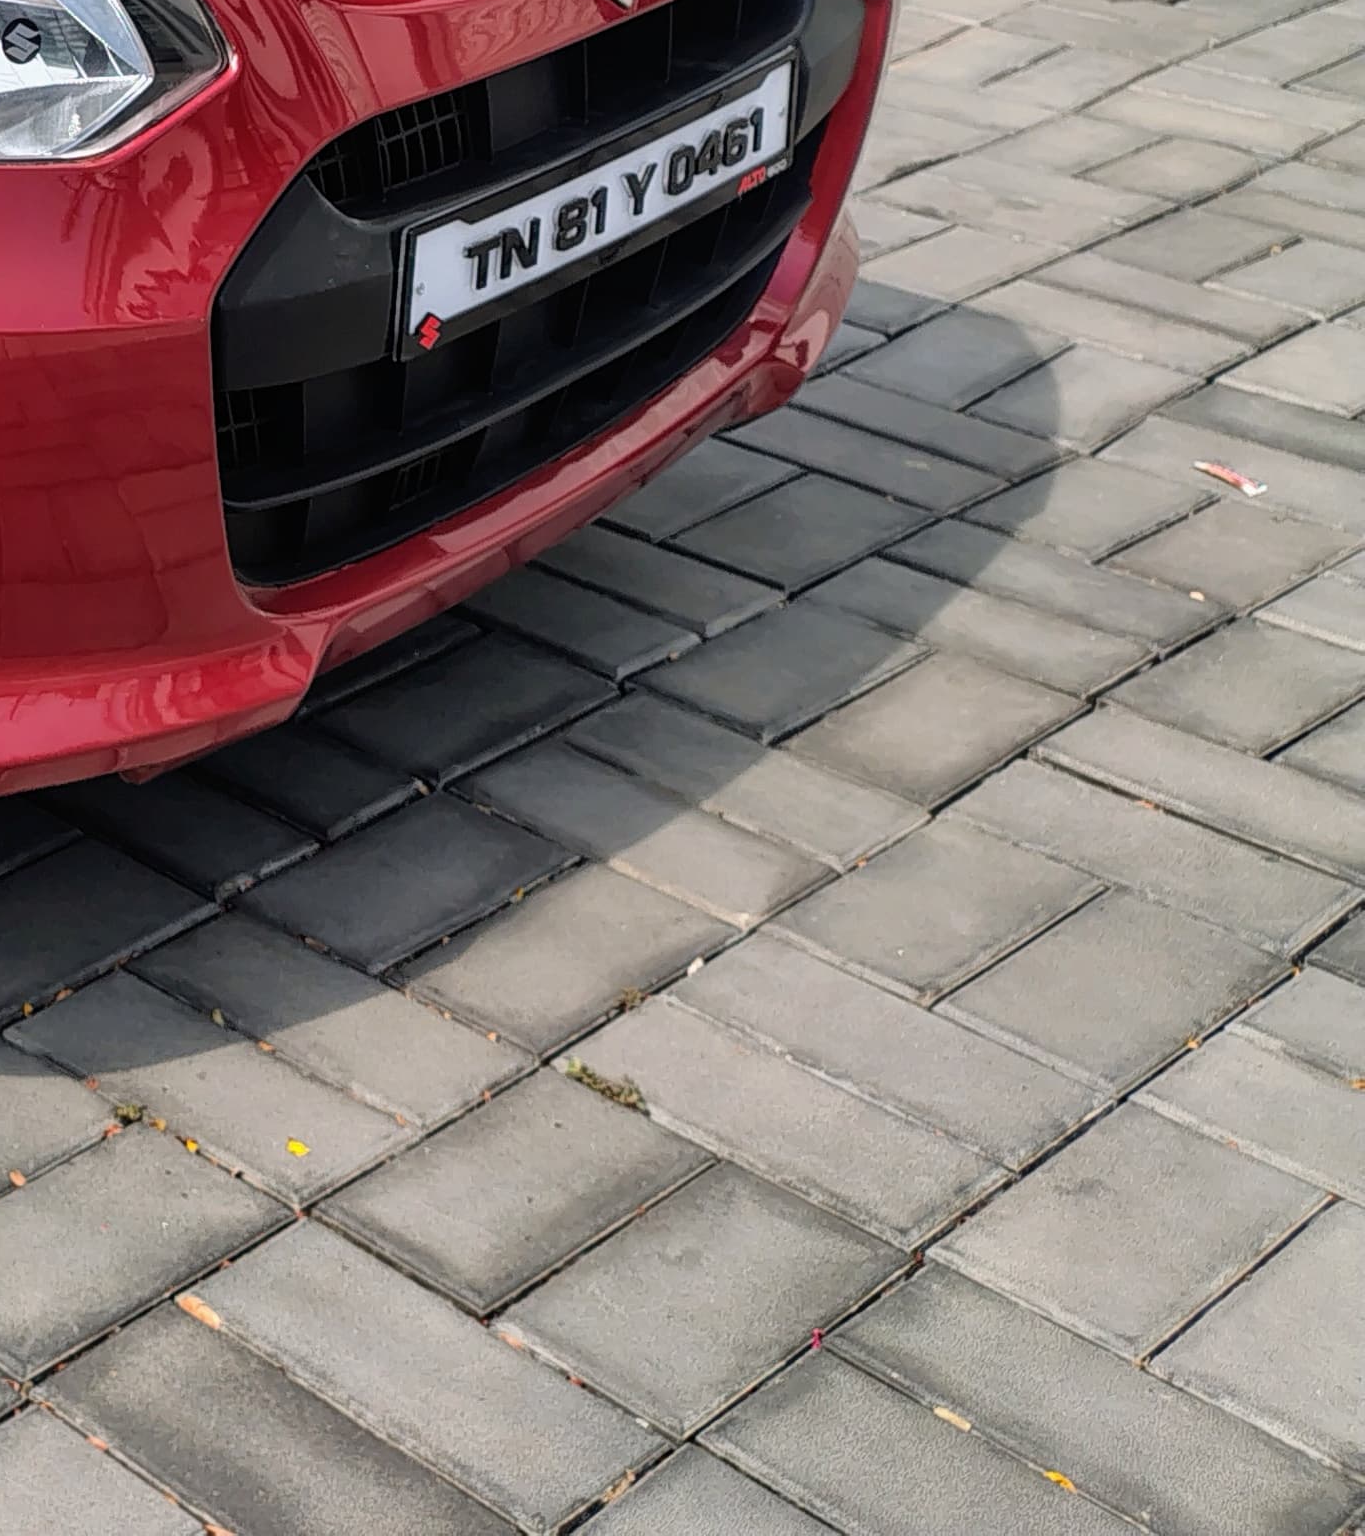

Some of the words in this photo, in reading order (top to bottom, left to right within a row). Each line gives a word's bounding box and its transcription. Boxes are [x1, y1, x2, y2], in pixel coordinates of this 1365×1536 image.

[465, 216, 541, 290] TN
[553, 186, 609, 252] 81
[622, 162, 658, 216] Y
[665, 107, 765, 196] 0461
[736, 165, 766, 195] ALTO
